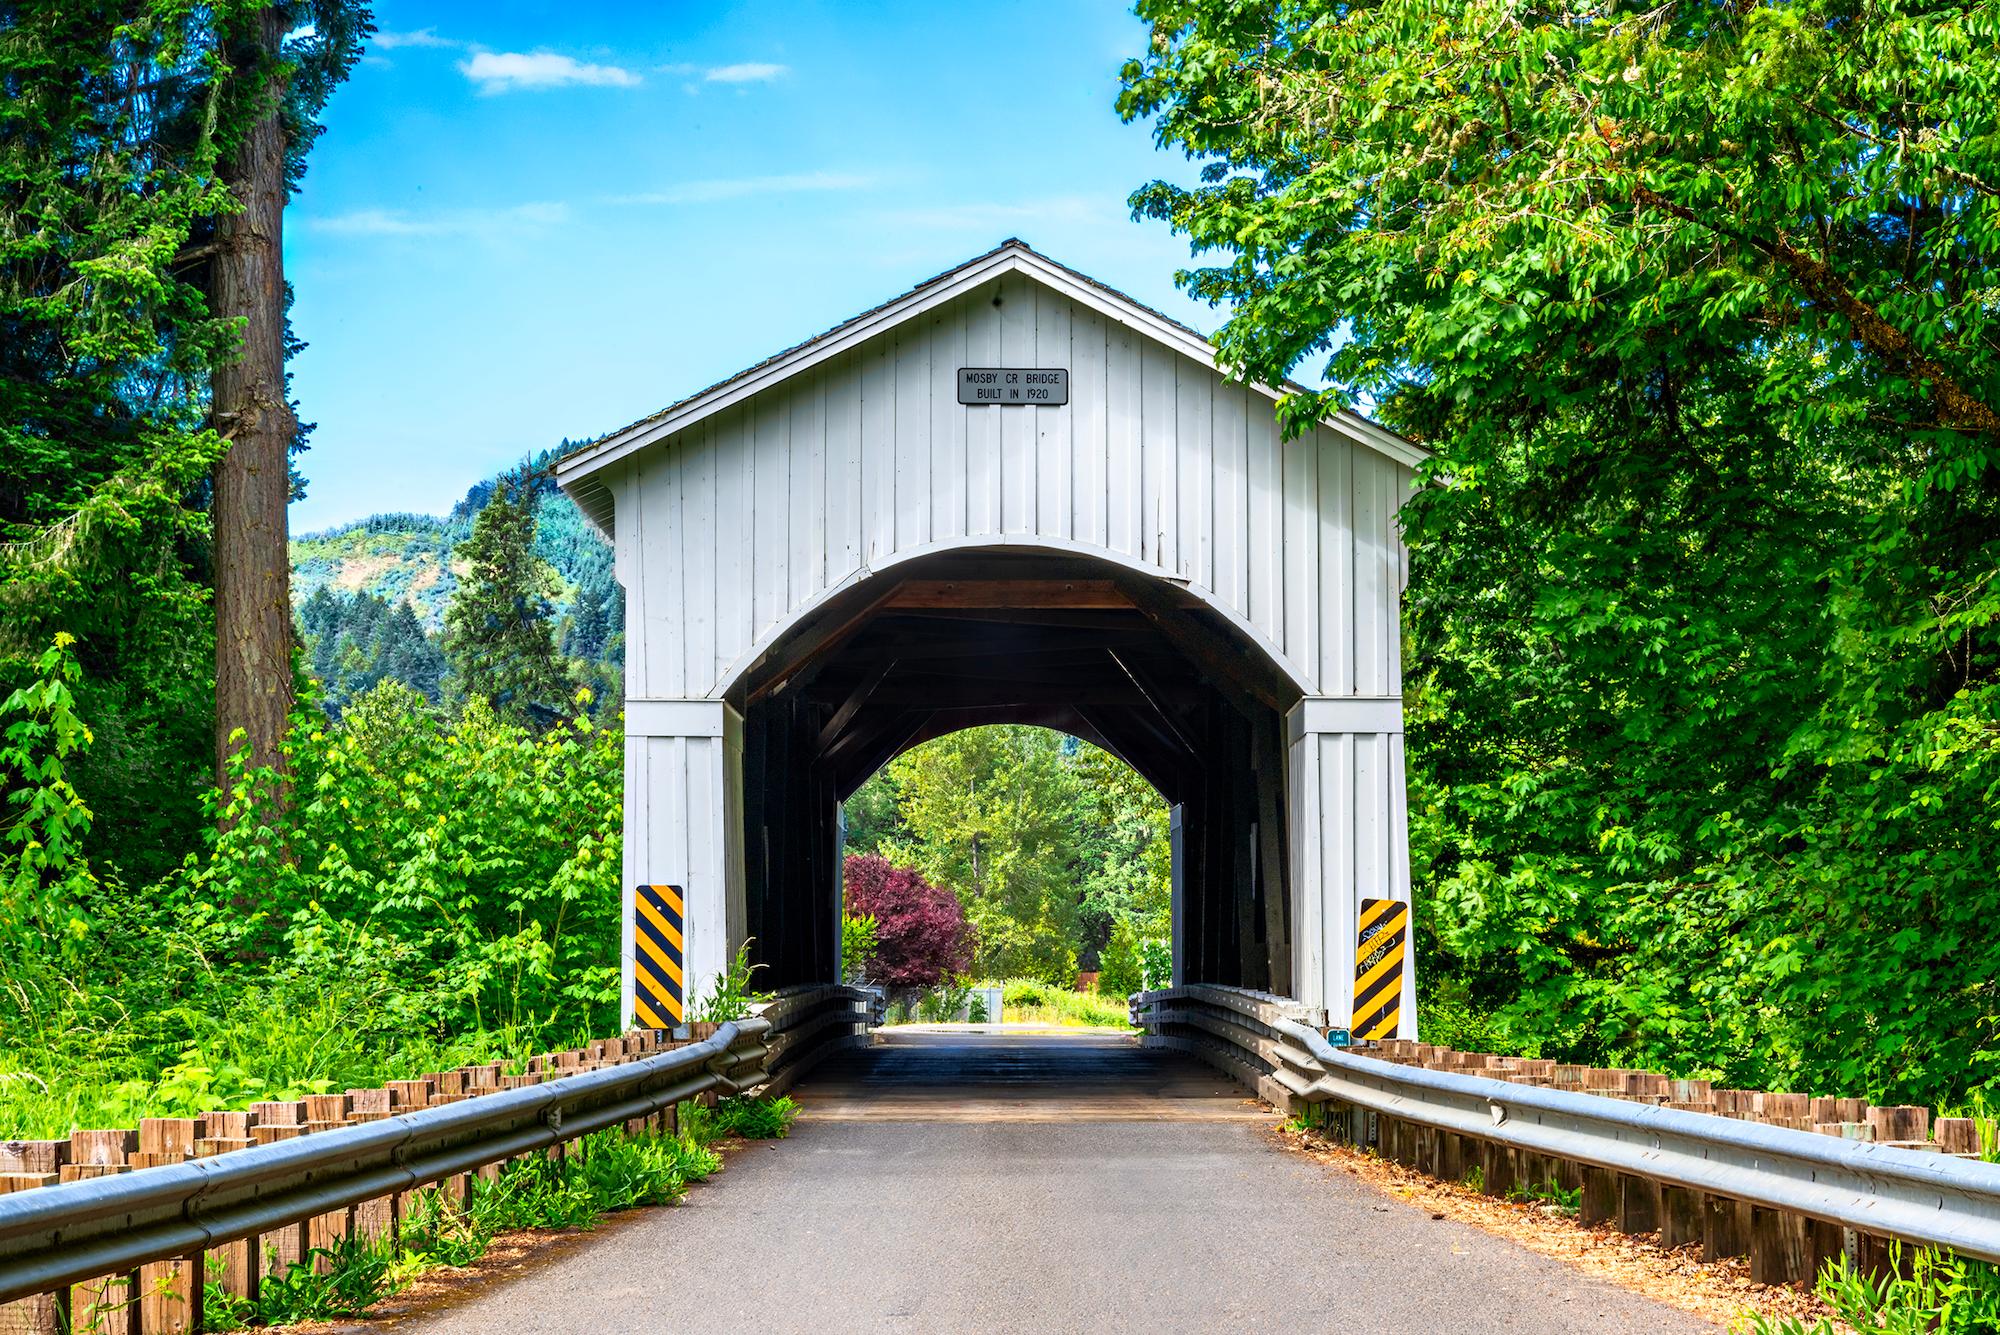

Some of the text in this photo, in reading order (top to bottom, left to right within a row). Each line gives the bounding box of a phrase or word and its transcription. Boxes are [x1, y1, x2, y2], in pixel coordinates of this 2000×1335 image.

[966, 373, 1060, 384] MOSBY CR BRIDGE
[977, 388, 1049, 399] BUILT IN 1920
